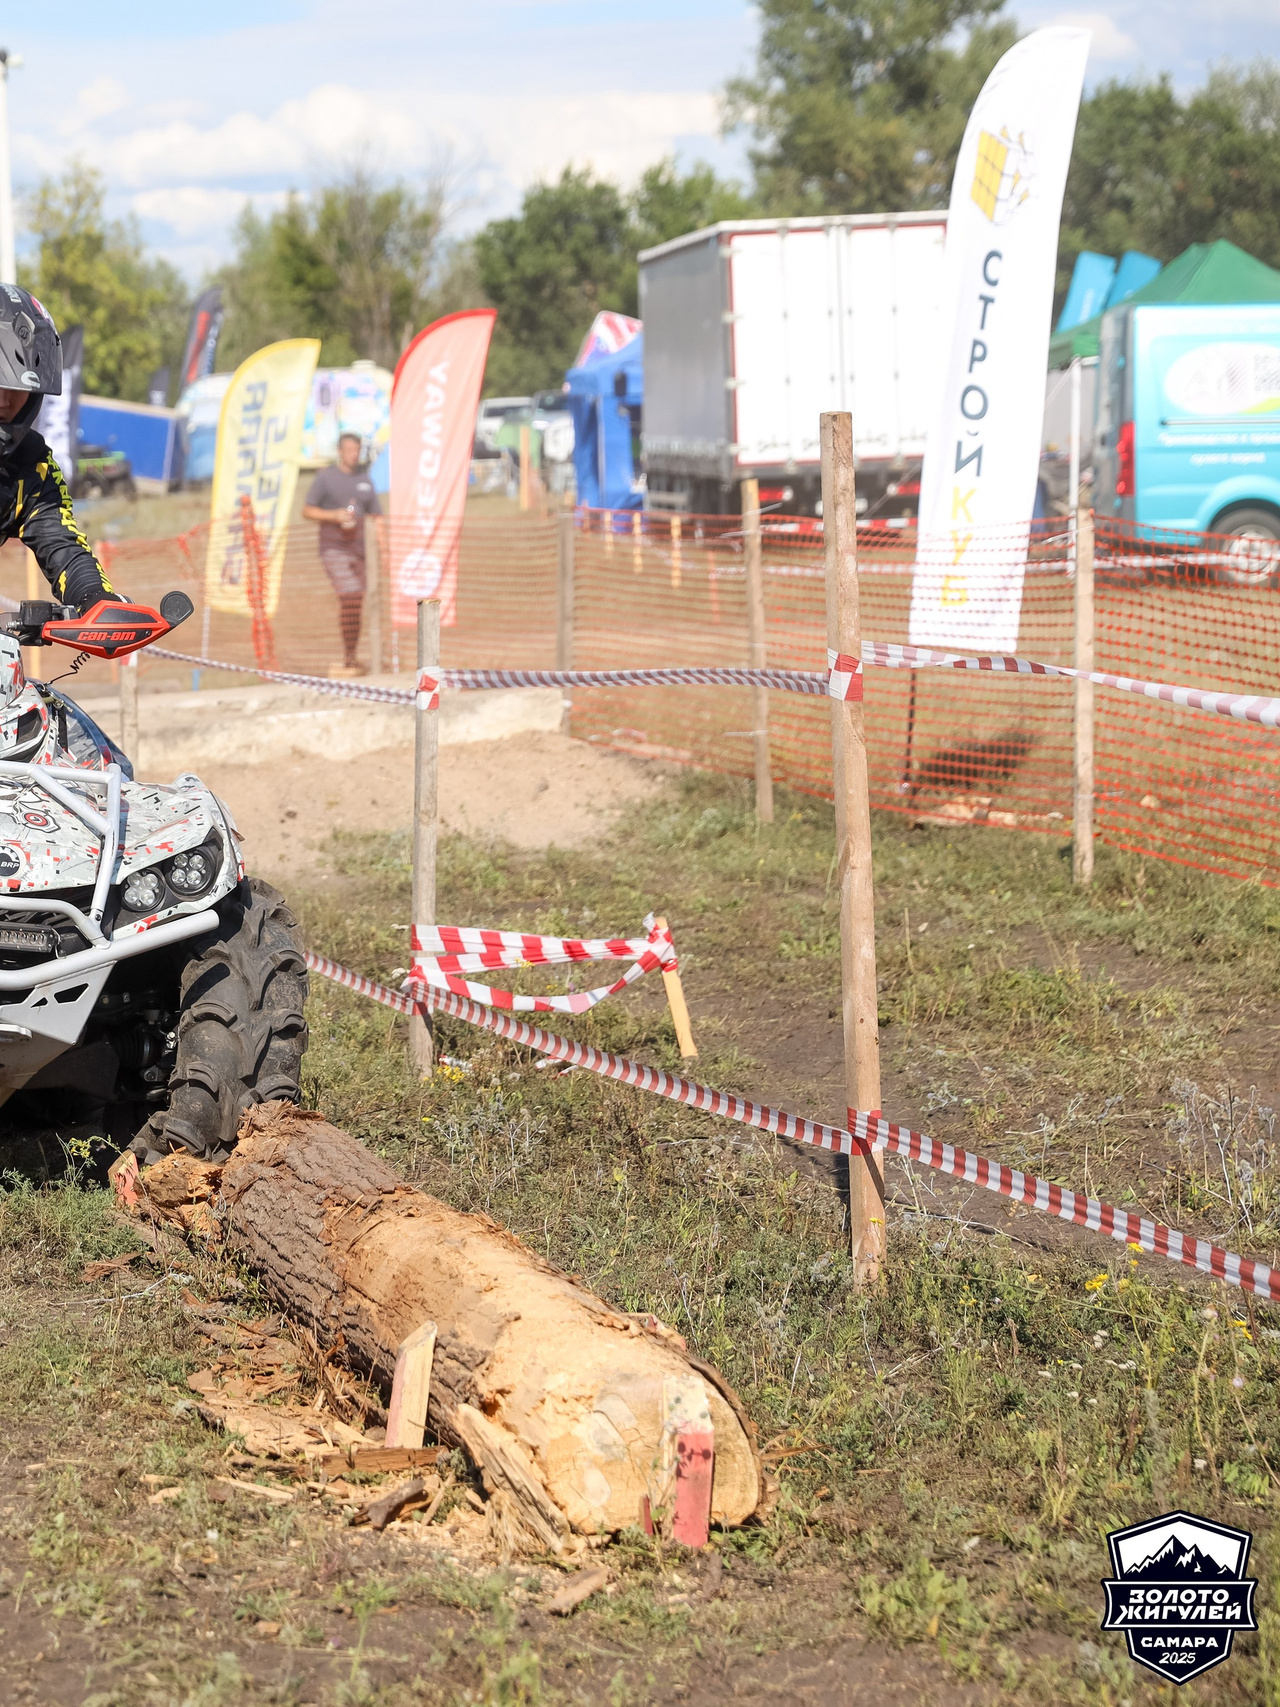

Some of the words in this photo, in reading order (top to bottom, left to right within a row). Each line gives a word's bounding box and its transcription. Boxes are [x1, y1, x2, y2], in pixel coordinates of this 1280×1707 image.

[954, 249, 1003, 478] СТРОЙ
[940, 486, 974, 608] КУБ
[77, 631, 136, 641] can-am
[0, 861, 20, 870] BRP
